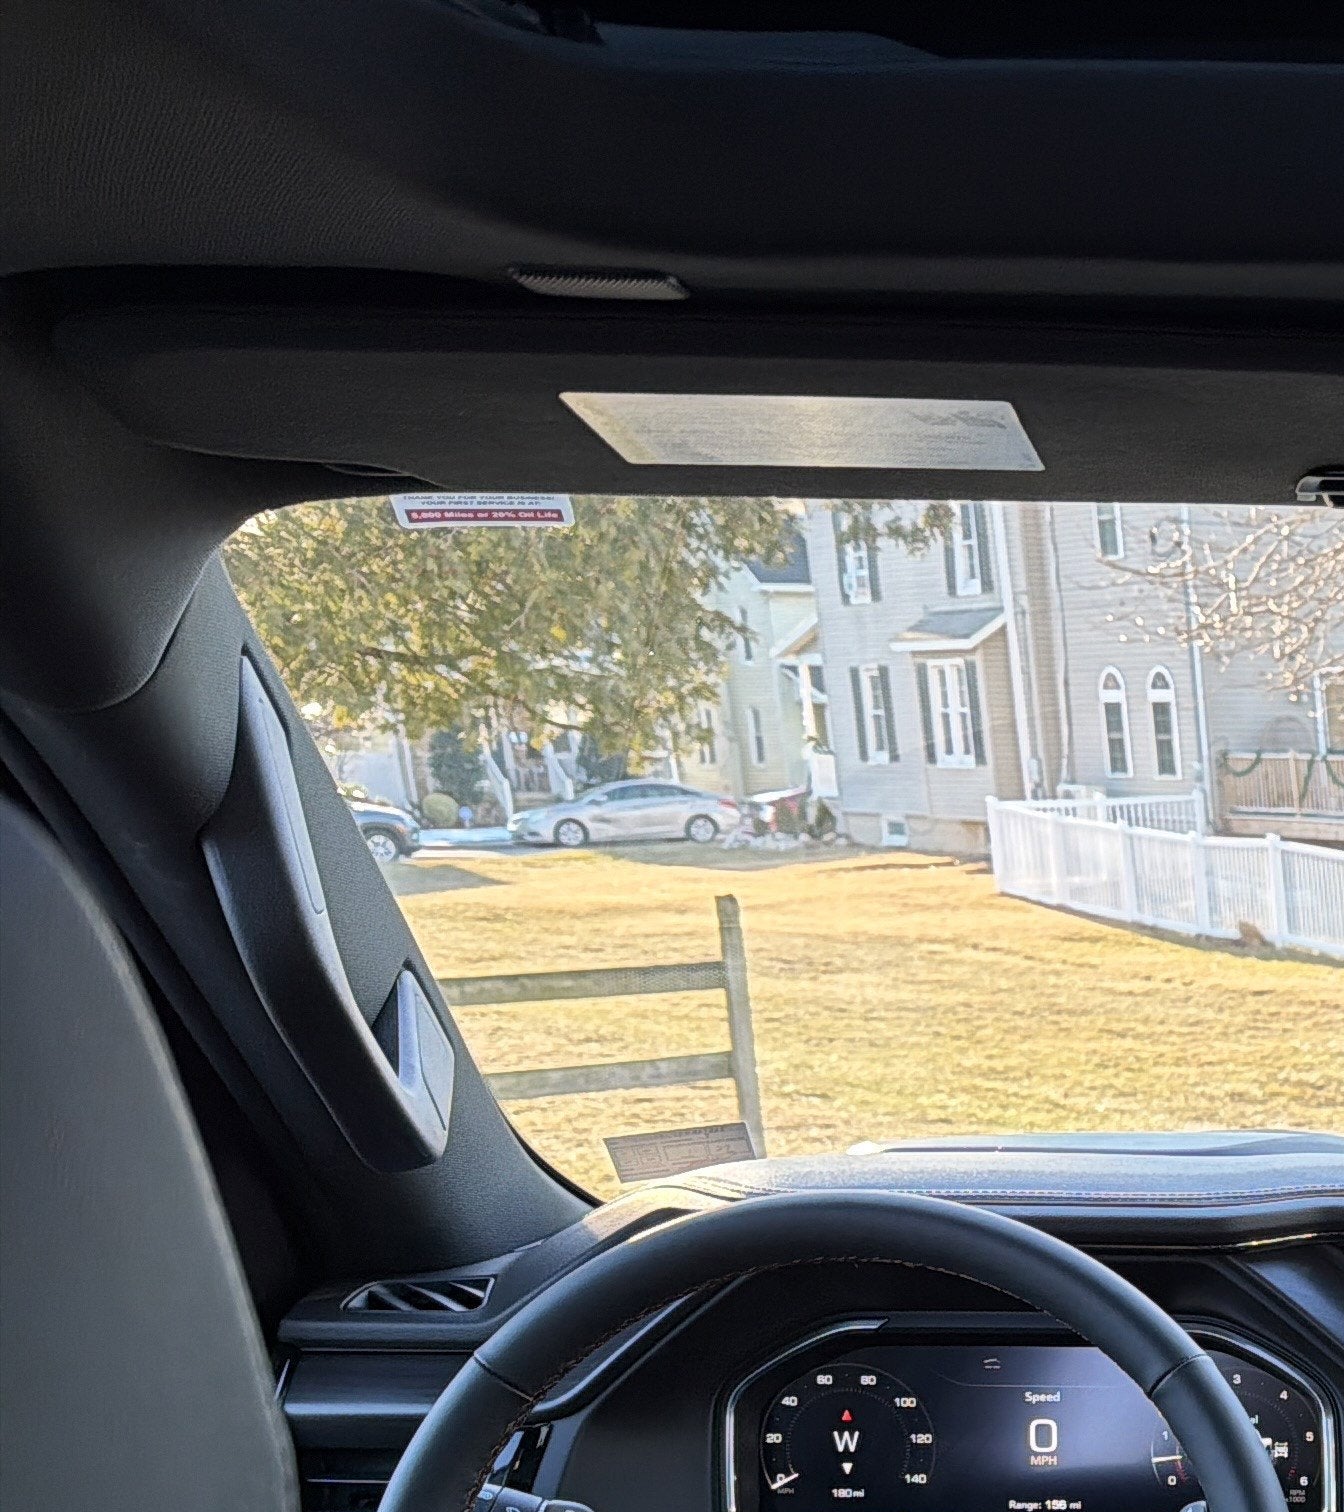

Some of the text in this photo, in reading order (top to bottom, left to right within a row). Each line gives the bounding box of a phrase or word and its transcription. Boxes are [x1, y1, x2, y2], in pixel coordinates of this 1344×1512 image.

[816, 1374, 833, 1385] 60
[1024, 1390, 1061, 1404] Speed
[1280, 1389, 1289, 1401] 4
[781, 1396, 798, 1407] 40
[894, 1397, 917, 1408] 100
[765, 1433, 782, 1444] 20
[910, 1433, 933, 1444] 120
[1029, 1418, 1058, 1453] 0
[1306, 1431, 1315, 1442] 5
[832, 1430, 860, 1453] W
[1030, 1455, 1058, 1467] MPH
[904, 1473, 927, 1484] 140
[1299, 1475, 1309, 1487] 6
[1008, 1499, 1042, 1512] Range:
